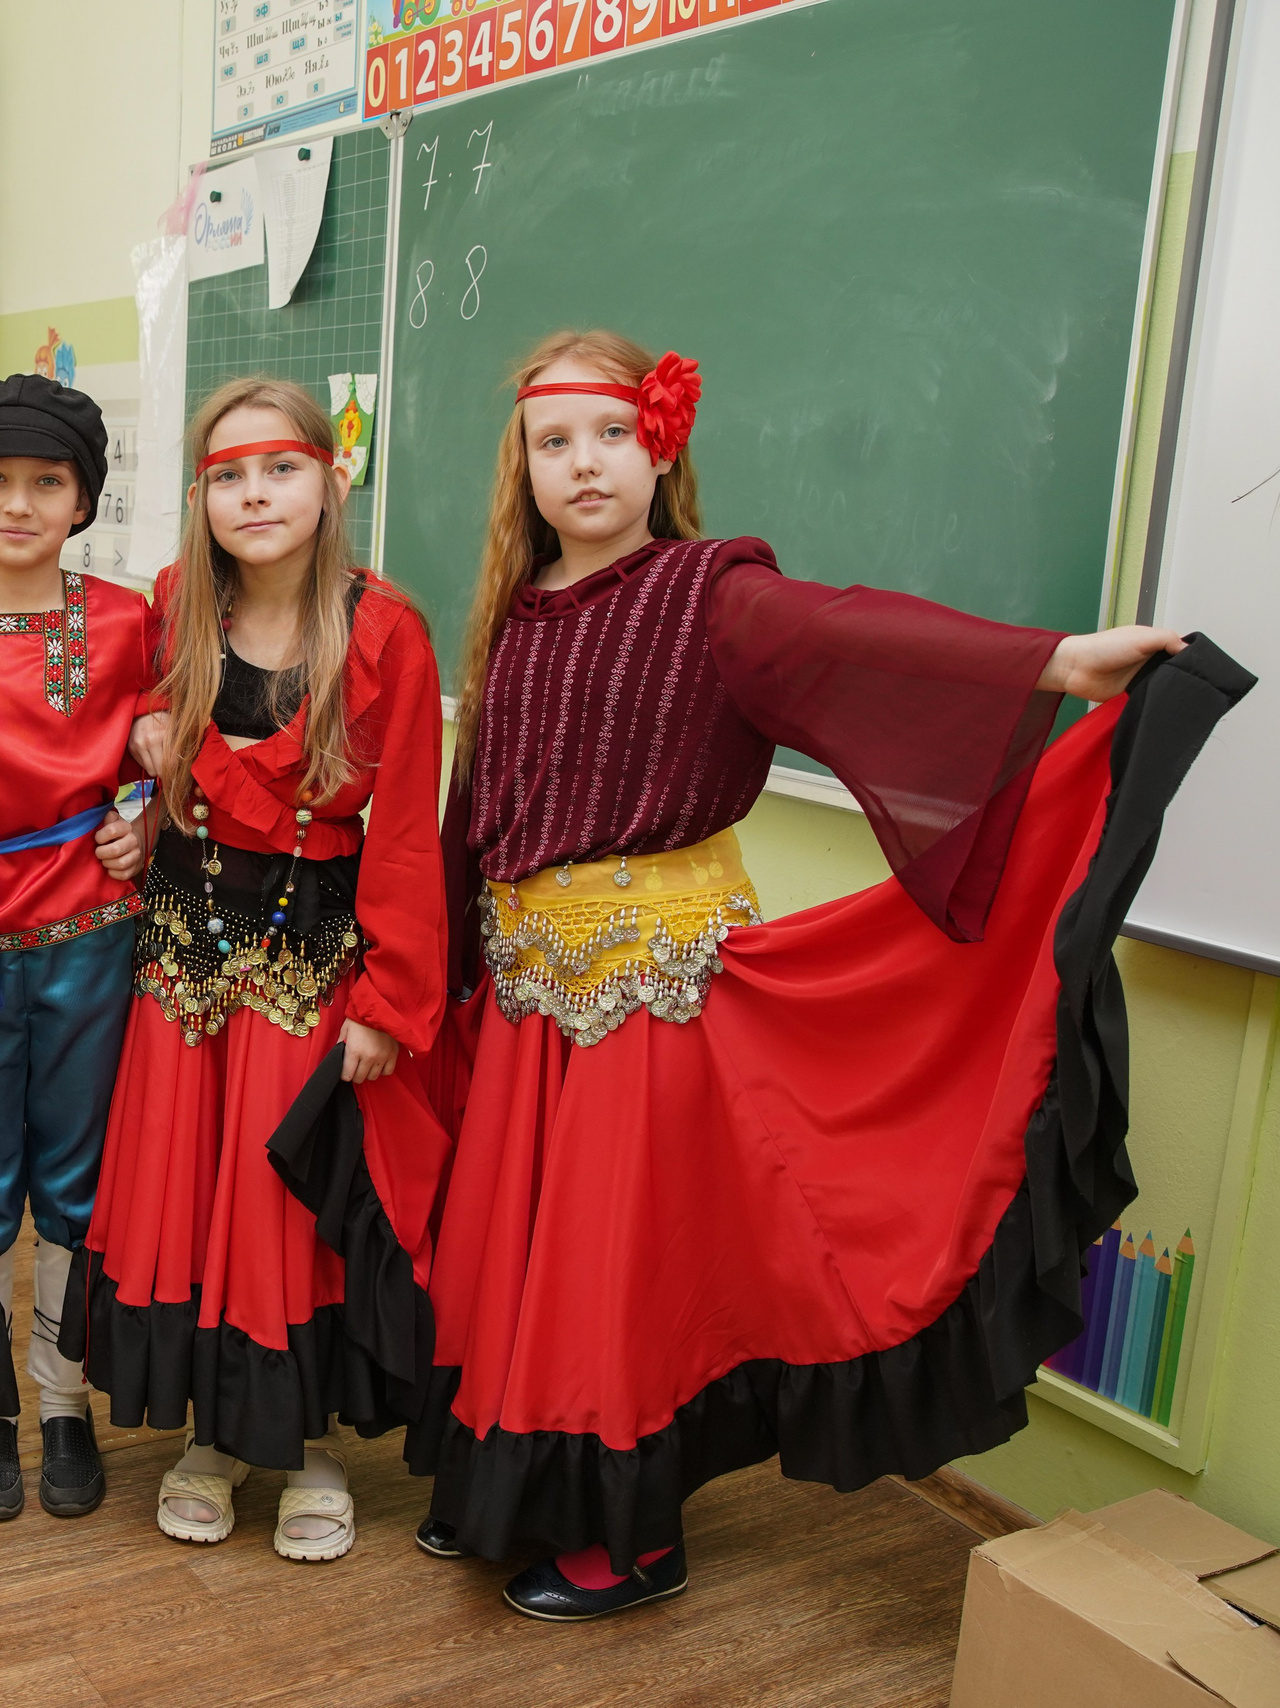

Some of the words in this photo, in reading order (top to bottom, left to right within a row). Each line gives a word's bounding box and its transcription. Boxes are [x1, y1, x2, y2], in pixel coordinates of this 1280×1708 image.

[256, 3, 268, 17] эф
[292, 37, 305, 51] ща
[256, 52, 268, 65] ша
[368, 57, 386, 107] 0
[395, 47, 408, 100] 1
[415, 39, 436, 95] 2
[442, 29, 463, 87] 3
[469, 20, 493, 77] 4
[499, 9, 522, 70] 5
[528, 0, 554, 61] 6
[562, 0, 588, 54] 7
[593, 0, 623, 43] 8
[224, 66, 233, 76] че
[210, 142, 238, 156] ШКОЛА
[194, 202, 243, 248] Орлята
[409, 260, 434, 329] 8
[460, 245, 487, 320] 8
